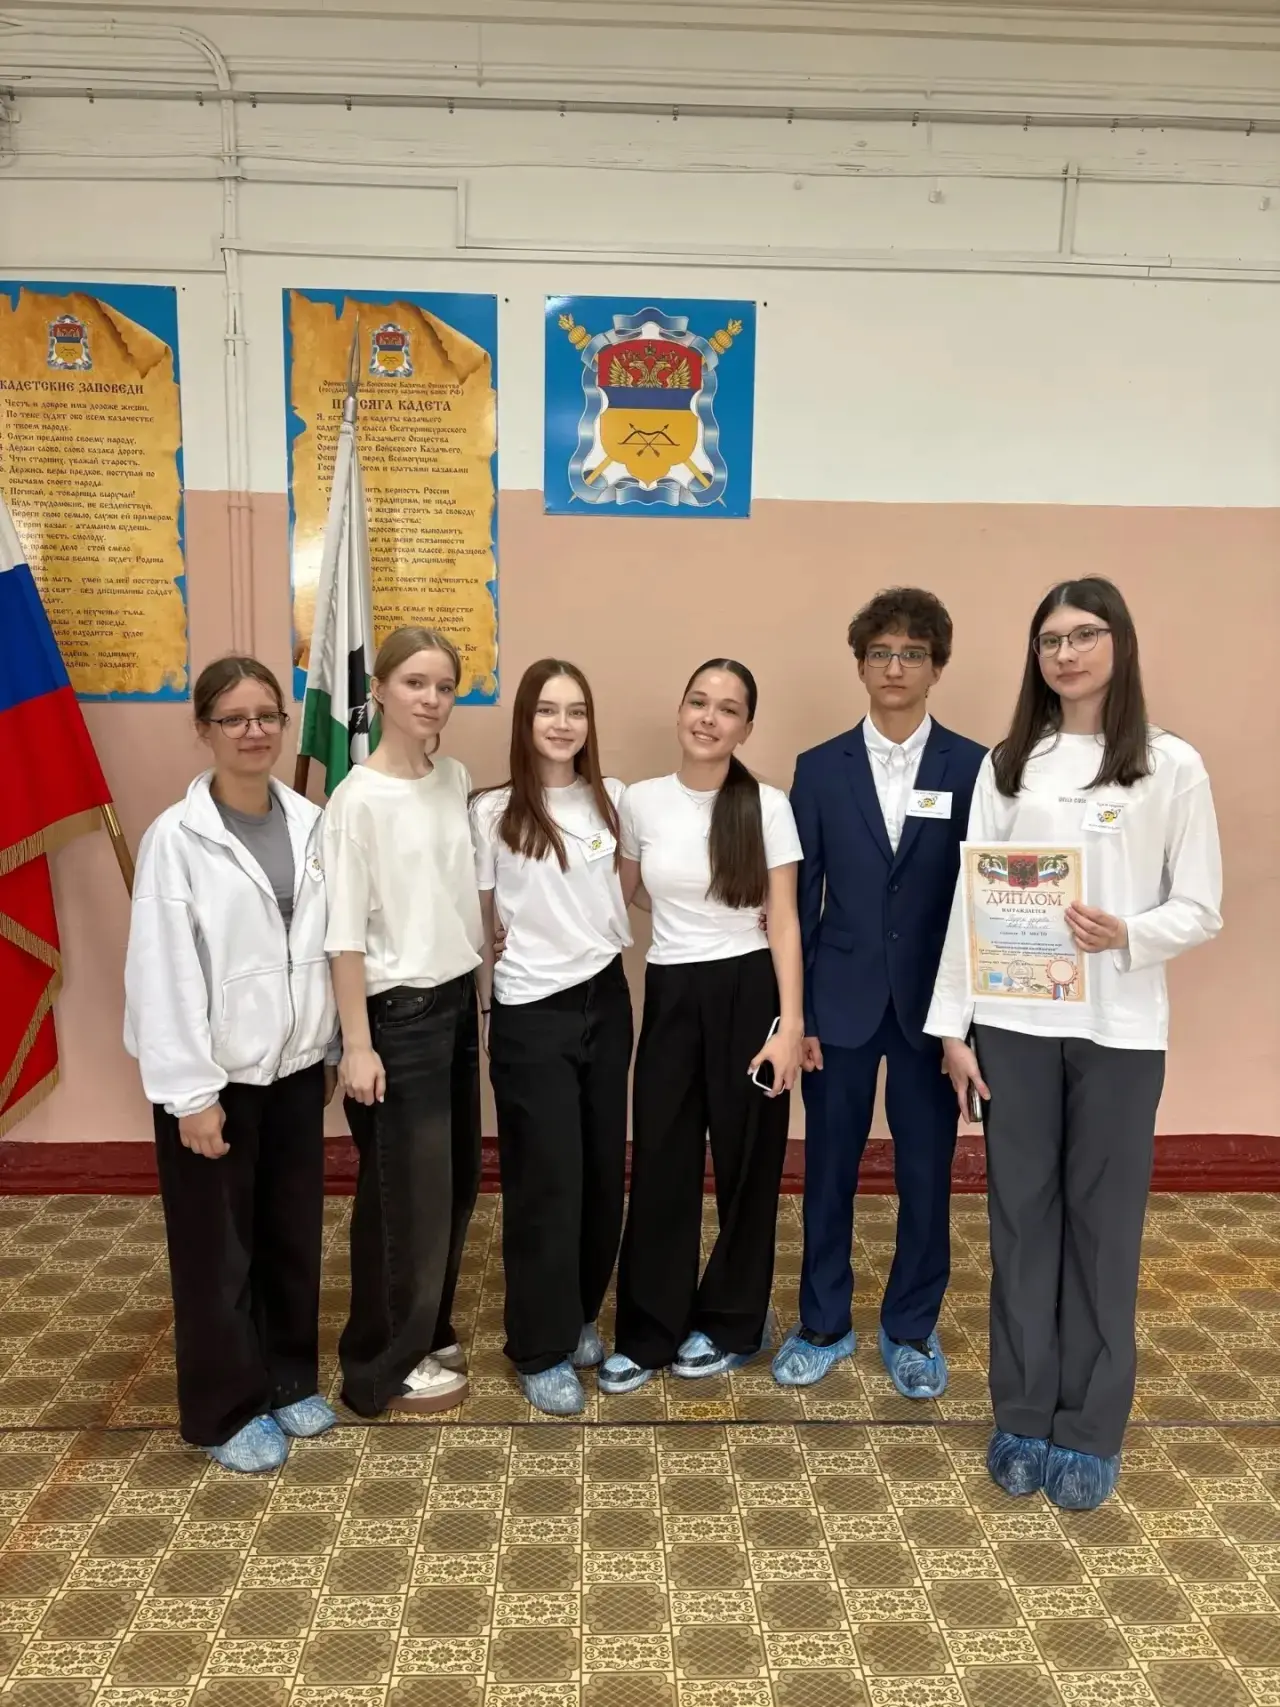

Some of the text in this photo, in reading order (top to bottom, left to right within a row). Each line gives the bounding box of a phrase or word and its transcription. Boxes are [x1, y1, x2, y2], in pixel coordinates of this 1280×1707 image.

[0, 380, 144, 396] КАДЕТСКИЕ ЗАПОВЕДИ
[398, 399, 452, 412] КАДЕТА
[986, 892, 1063, 906] ДИПЛОМ
